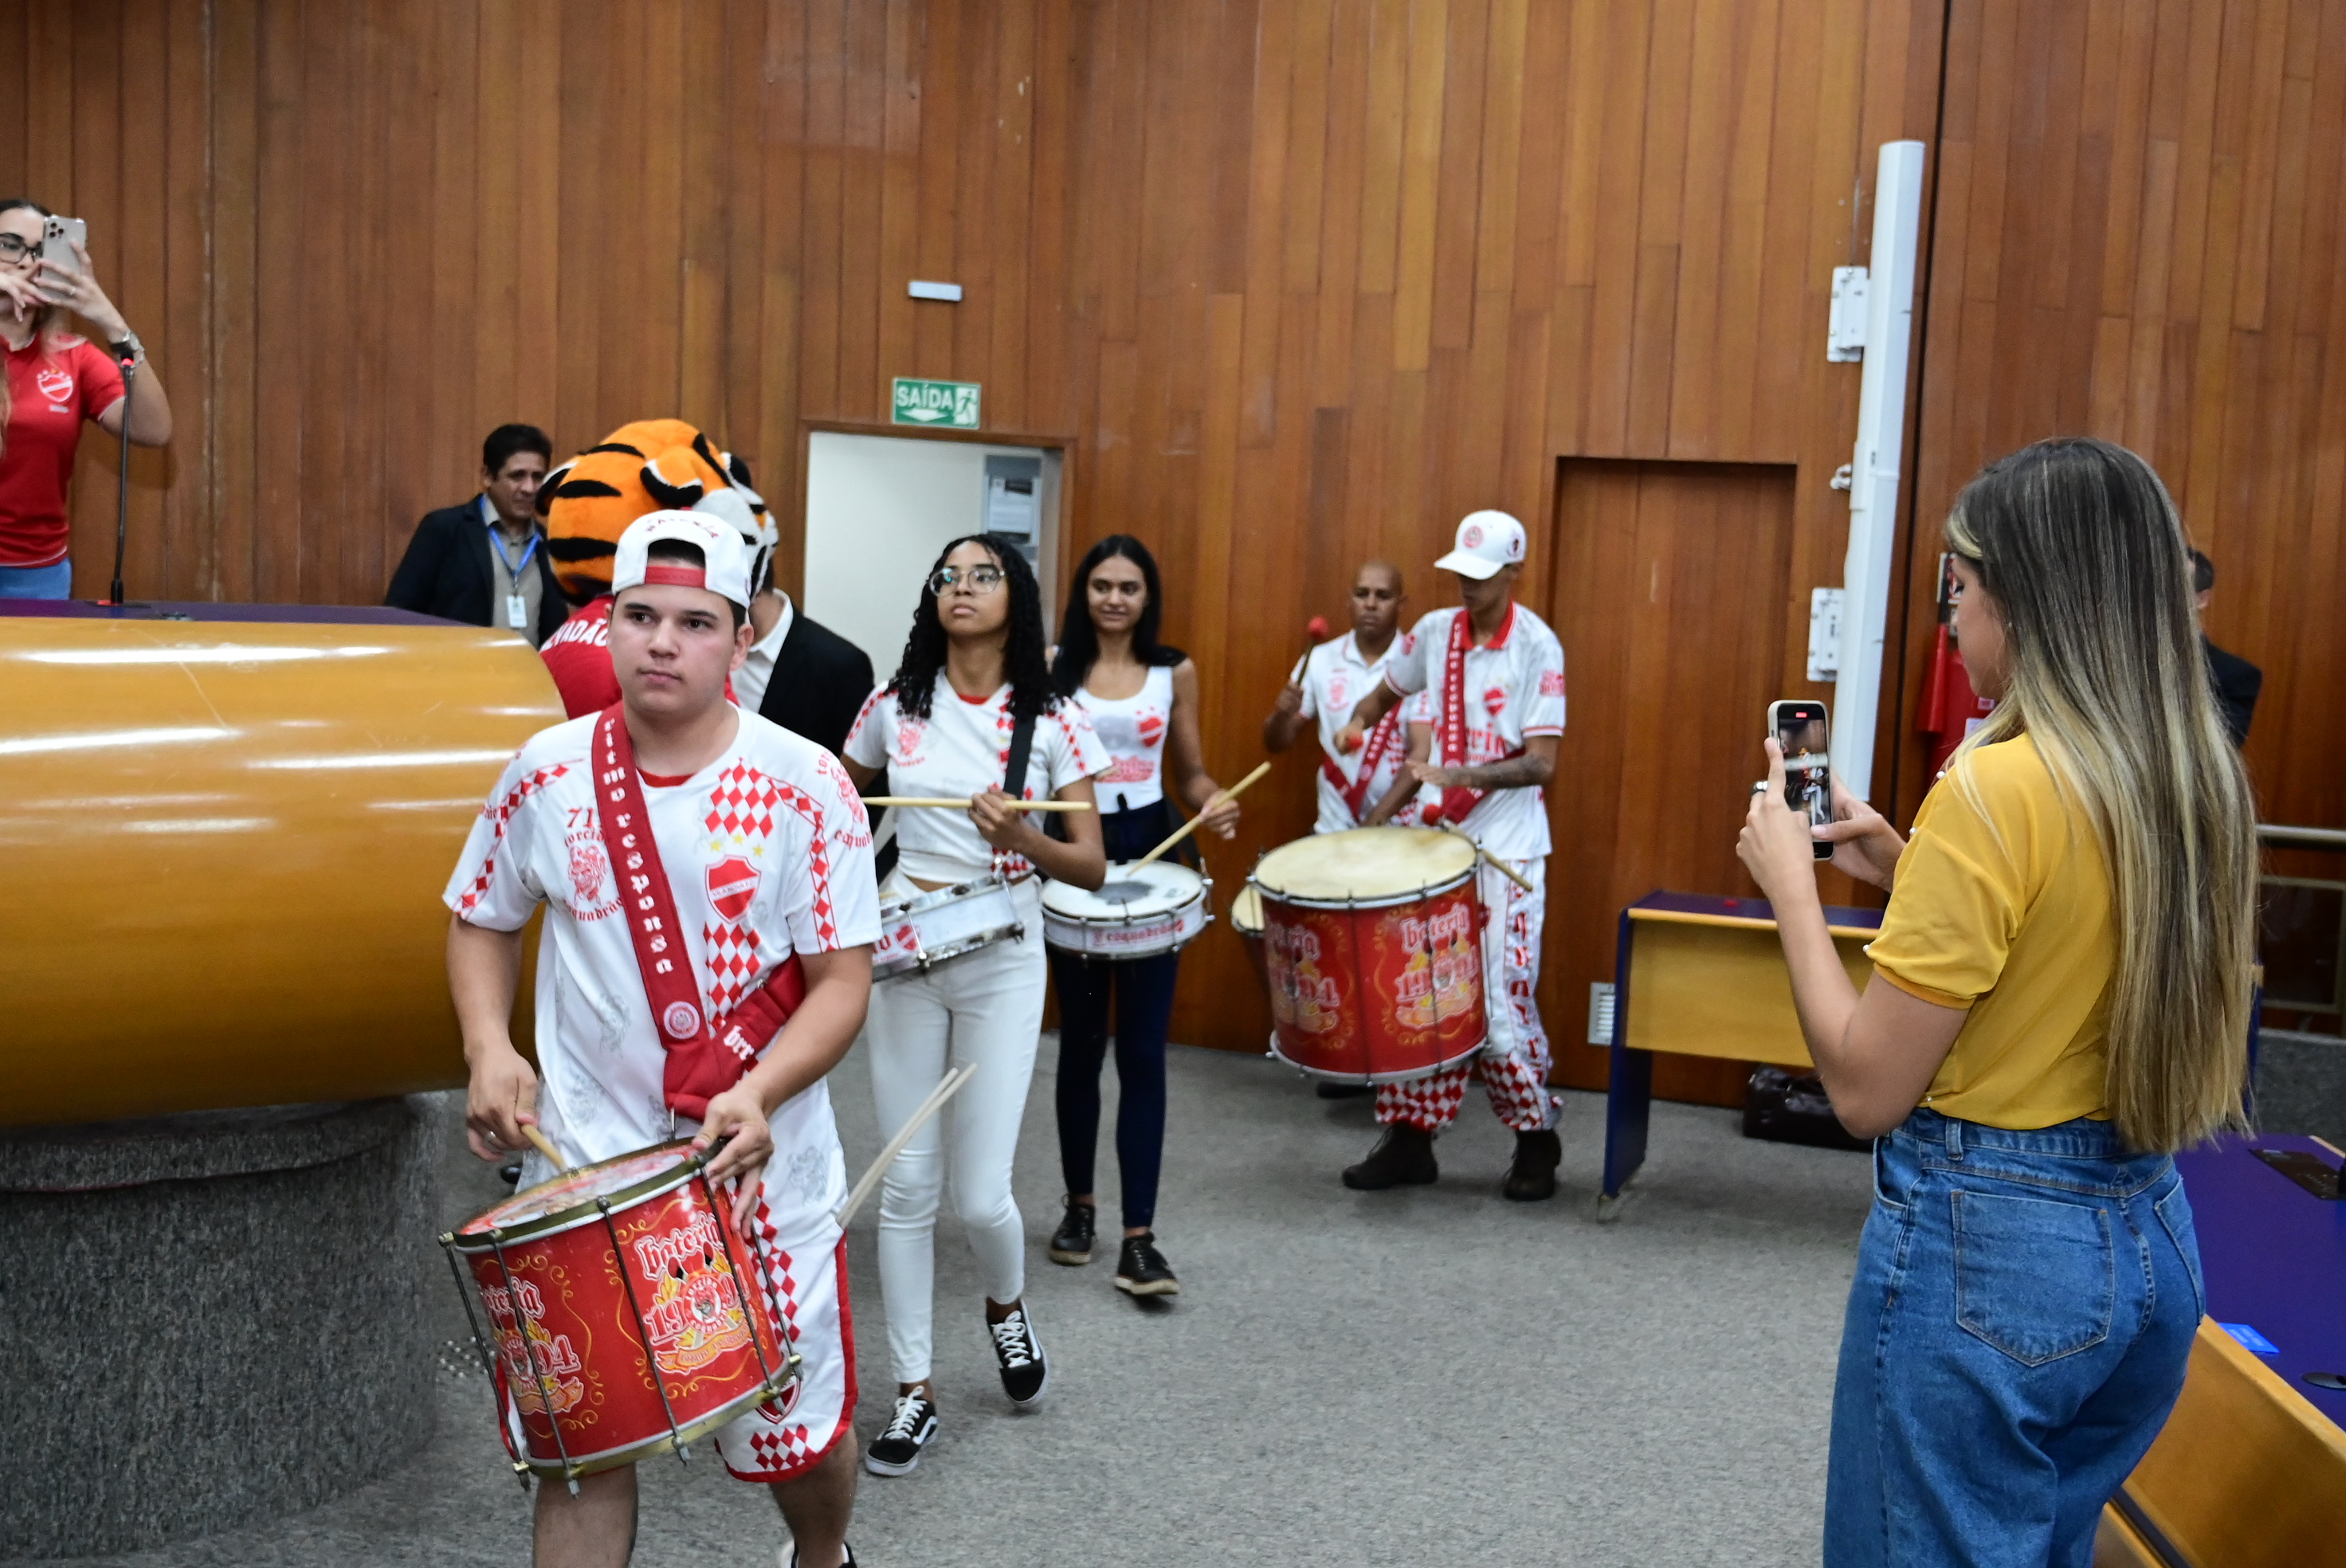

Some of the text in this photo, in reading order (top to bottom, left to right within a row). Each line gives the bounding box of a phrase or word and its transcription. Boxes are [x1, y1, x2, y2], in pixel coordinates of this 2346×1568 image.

[897, 383, 954, 410] SAÍDA
[567, 807, 594, 828] 71
[616, 813, 673, 974] responsa
